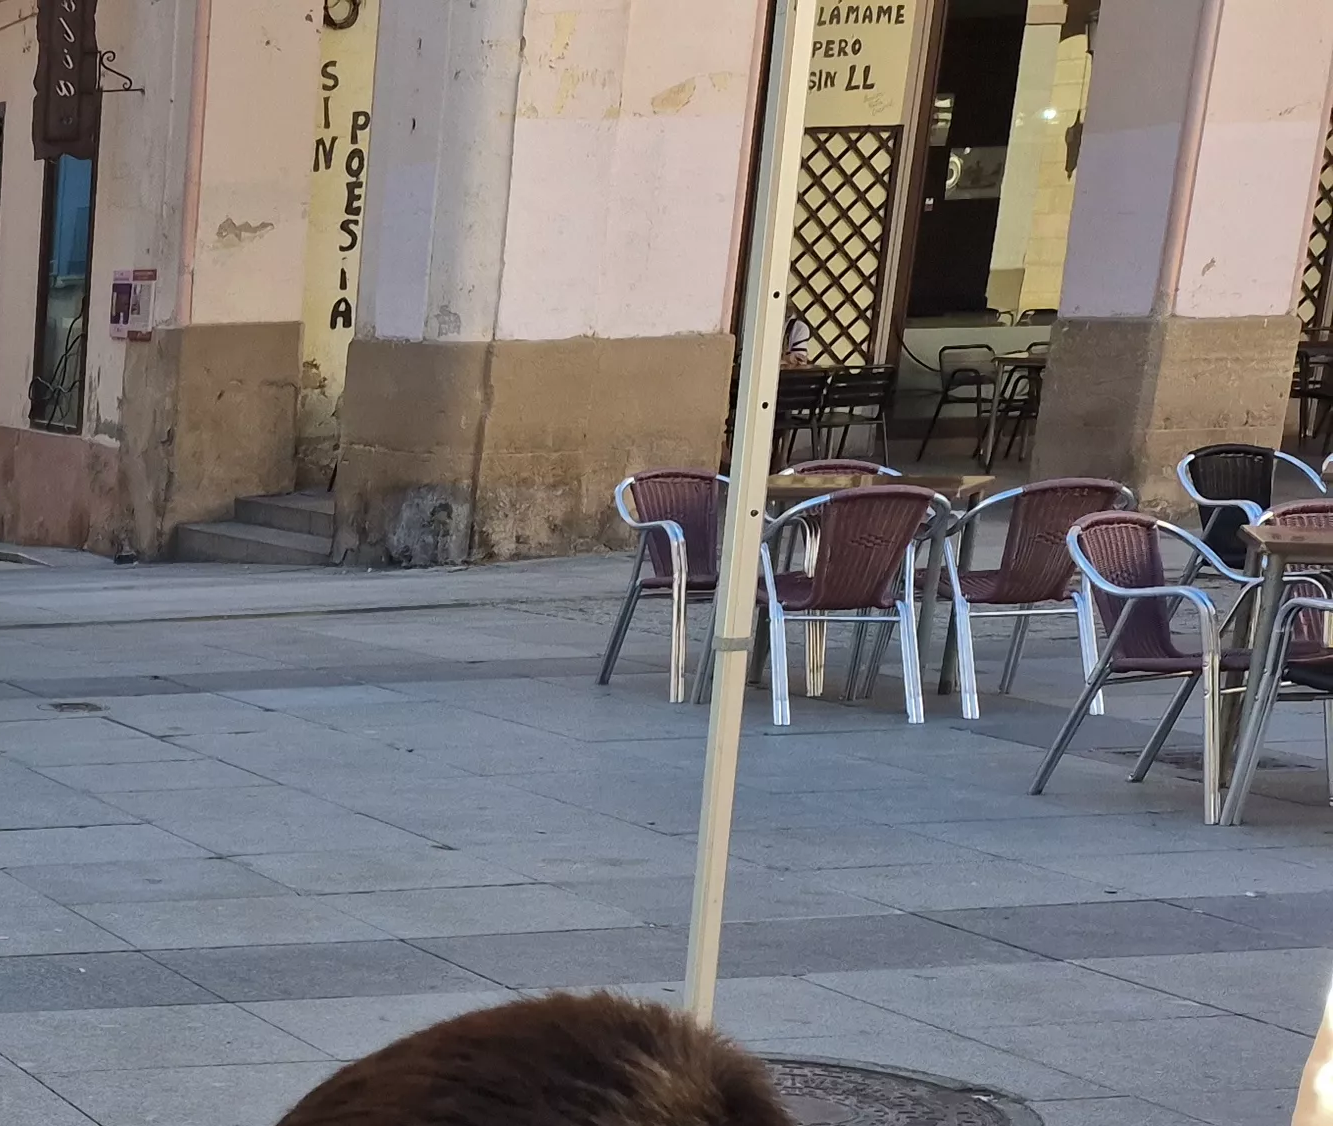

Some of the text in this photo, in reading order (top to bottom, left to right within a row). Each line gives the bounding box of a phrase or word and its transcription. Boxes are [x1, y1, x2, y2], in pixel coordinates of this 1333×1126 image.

[793, 0, 905, 26] LÁMAME
[812, 38, 862, 58] PERO
[808, 64, 875, 92] SIN LL
[312, 60, 339, 172] SIN
